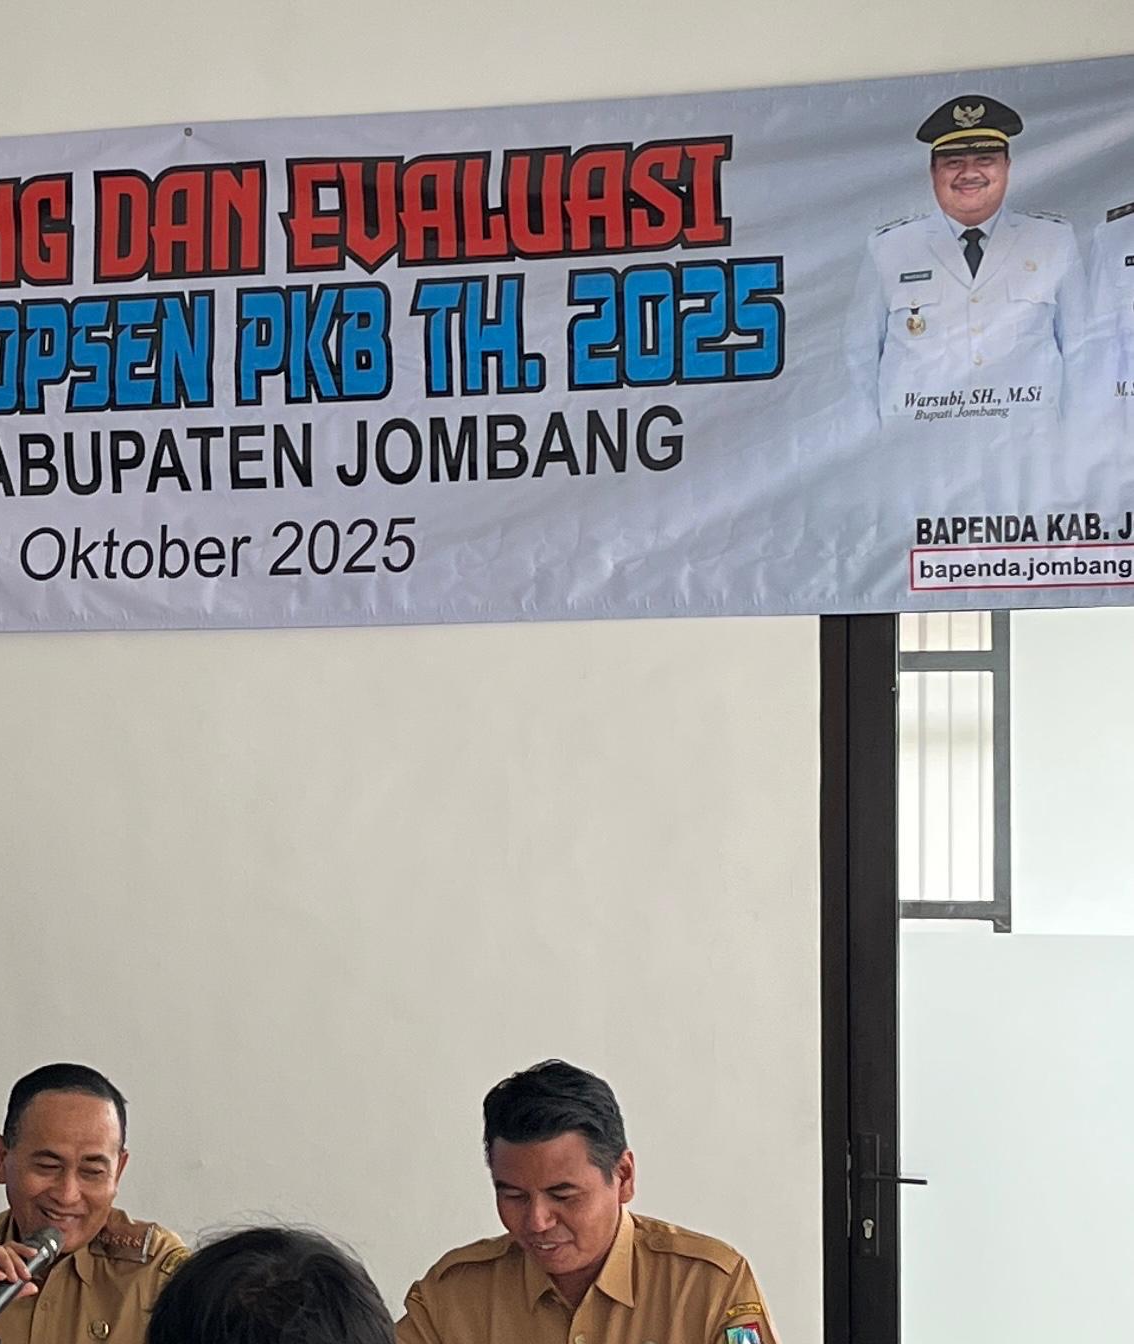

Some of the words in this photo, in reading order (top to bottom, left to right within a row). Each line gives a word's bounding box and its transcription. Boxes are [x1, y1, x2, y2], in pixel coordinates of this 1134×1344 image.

[94, 161, 265, 282] DAN
[279, 135, 733, 274] EVALUASI
[235, 281, 394, 406] PKB
[410, 273, 546, 398] TH.
[567, 256, 784, 391] 2025
[904, 390, 965, 407] Warsubi,
[1006, 386, 1042, 402] M.Si
[914, 408, 952, 421] Bupati
[955, 407, 1009, 419] Jombang
[336, 406, 685, 487] JOMBANG
[20, 522, 251, 580] Oktober
[269, 517, 416, 576] 2025
[916, 515, 1039, 545] BAPENDA
[1047, 512, 1109, 541] KAB.
